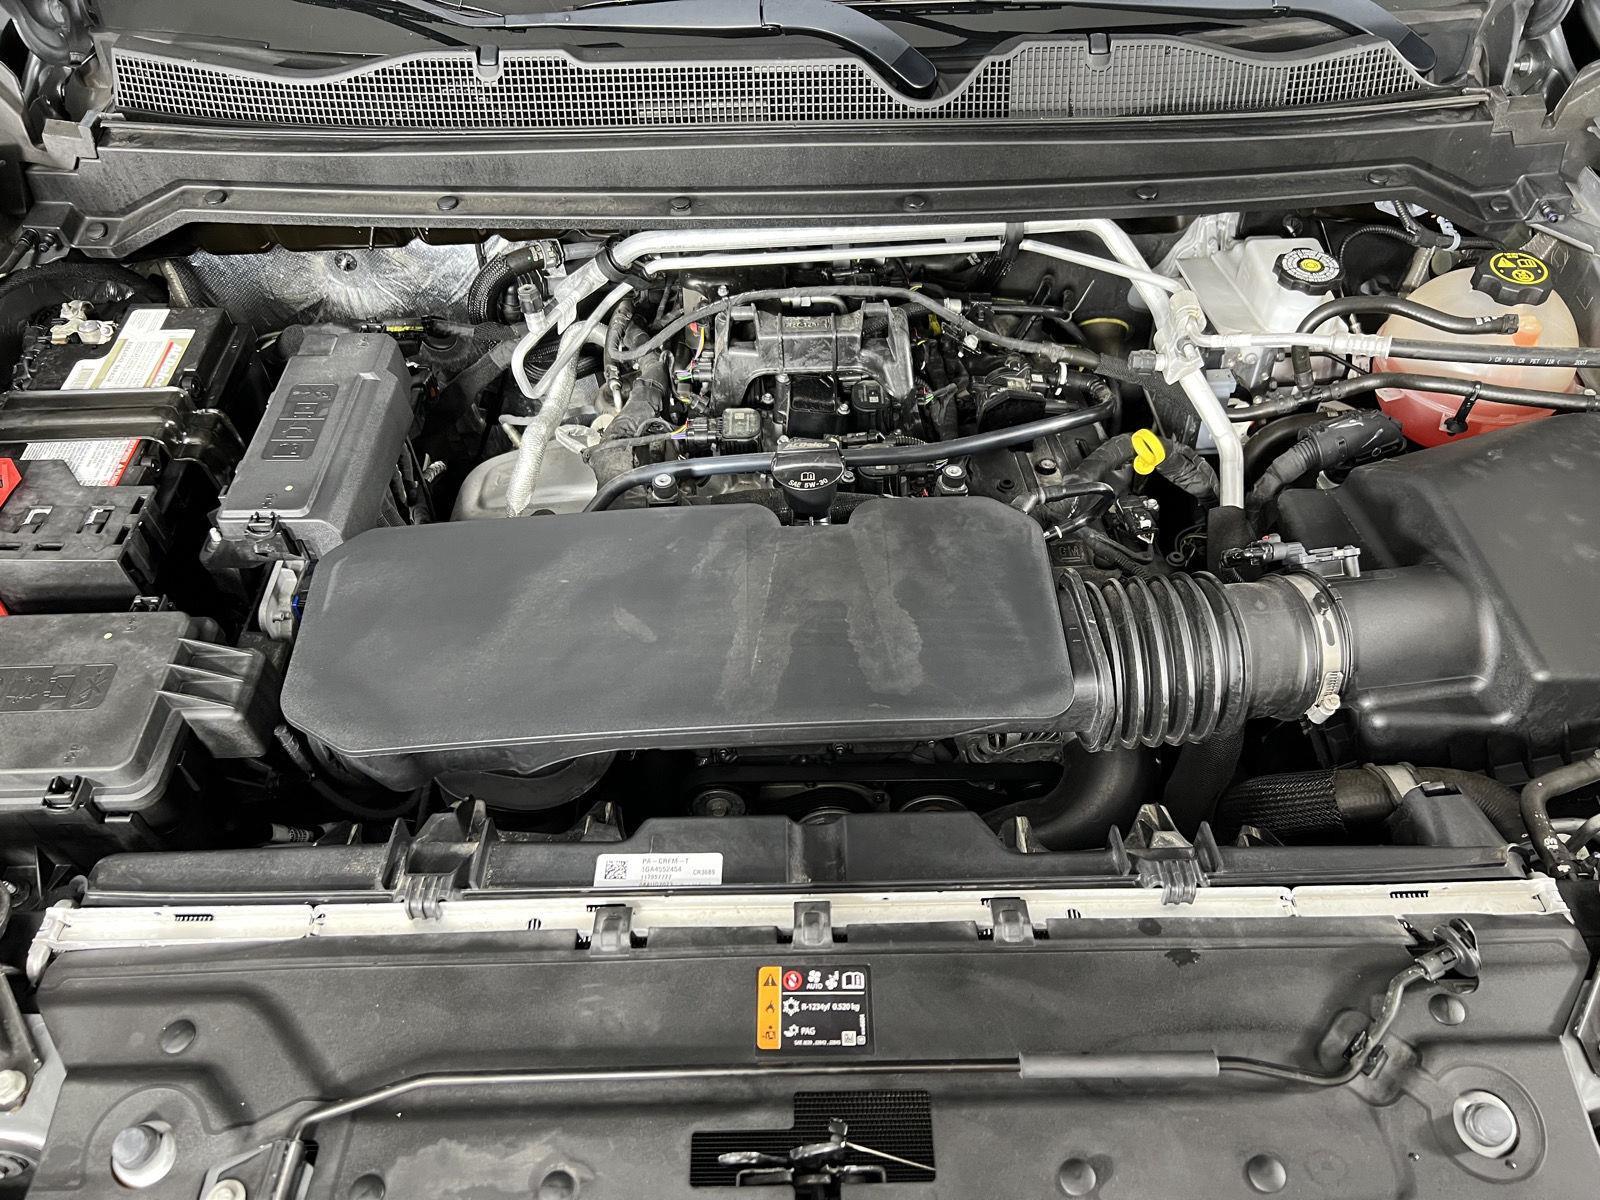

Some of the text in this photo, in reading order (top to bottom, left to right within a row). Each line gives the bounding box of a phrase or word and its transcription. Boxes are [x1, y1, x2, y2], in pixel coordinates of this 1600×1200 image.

[788, 478, 829, 488] SAE 5W-30
[1059, 545, 1085, 557] GM
[801, 1002, 861, 1012] R-1234yf 0.520 kg
[800, 1026, 816, 1036] PAG
